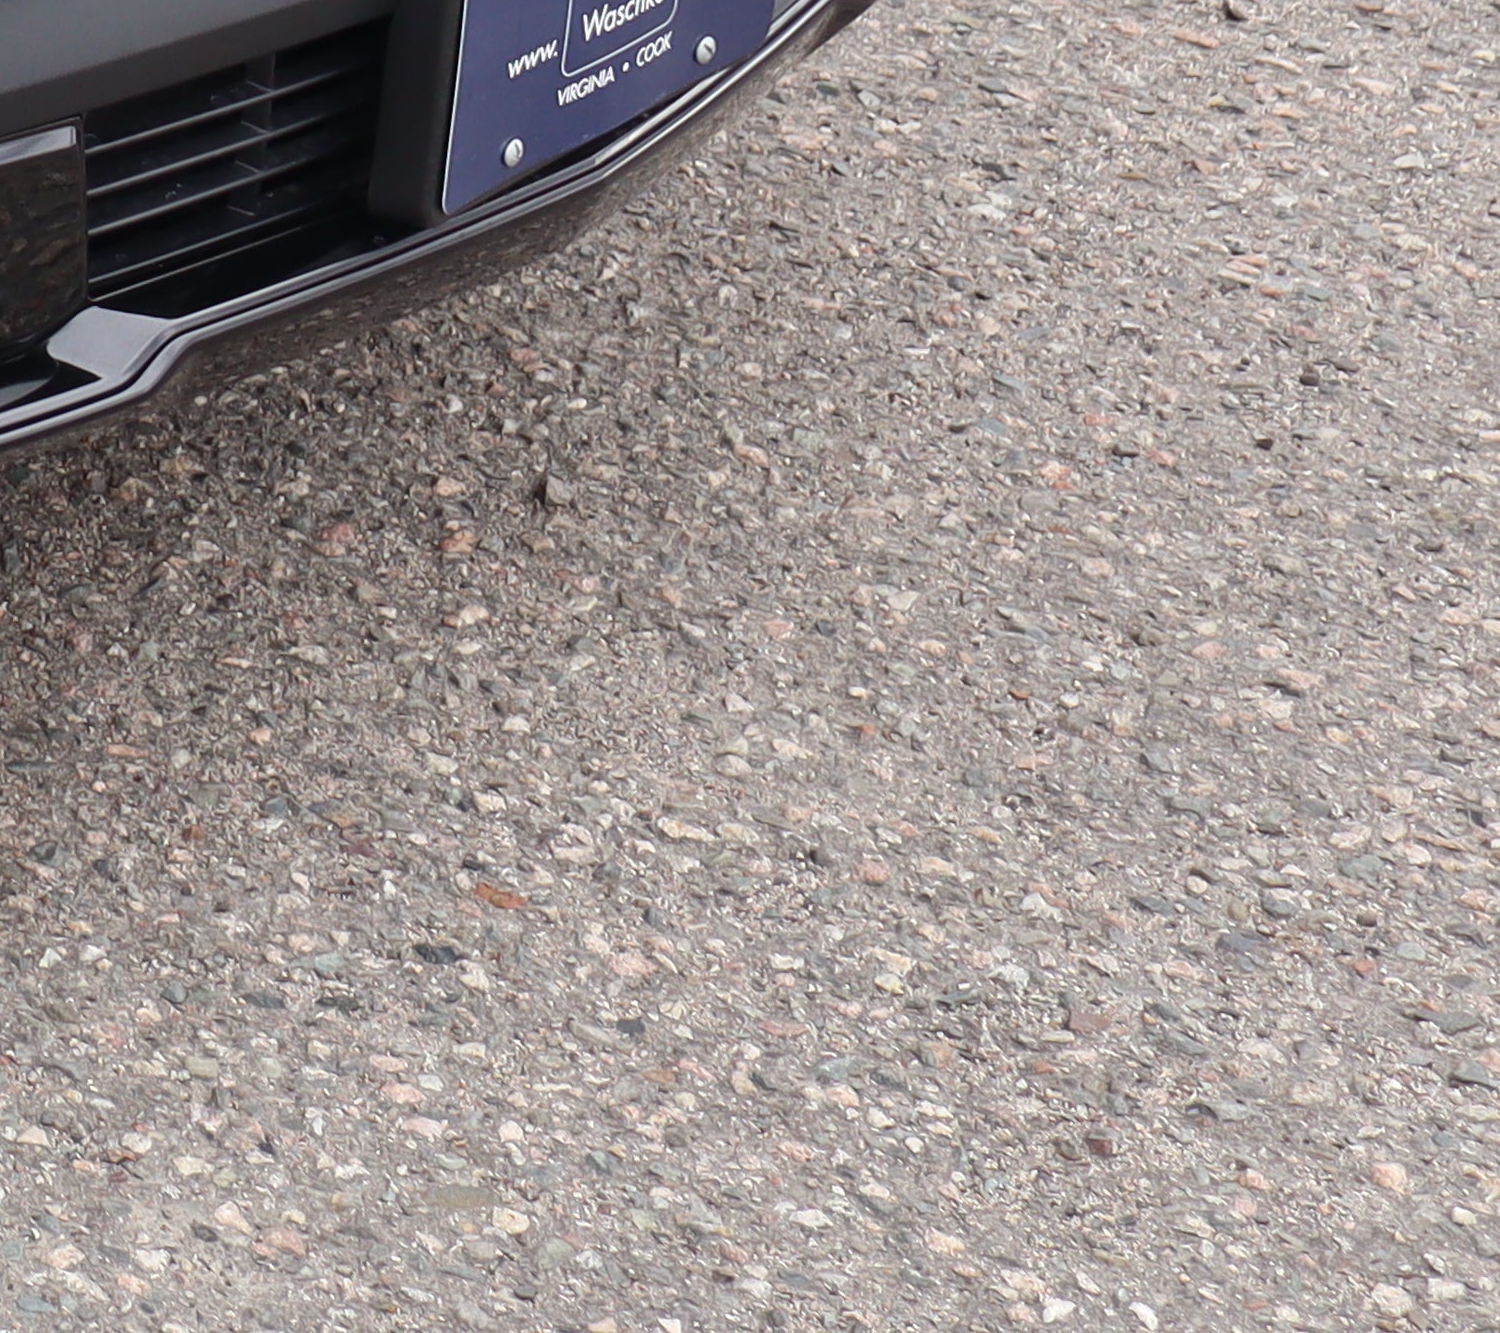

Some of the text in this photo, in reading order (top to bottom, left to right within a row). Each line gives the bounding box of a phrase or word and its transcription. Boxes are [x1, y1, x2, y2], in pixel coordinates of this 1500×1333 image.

[506, 38, 559, 80] www.
[557, 32, 672, 106] VIRGINIA COOK
